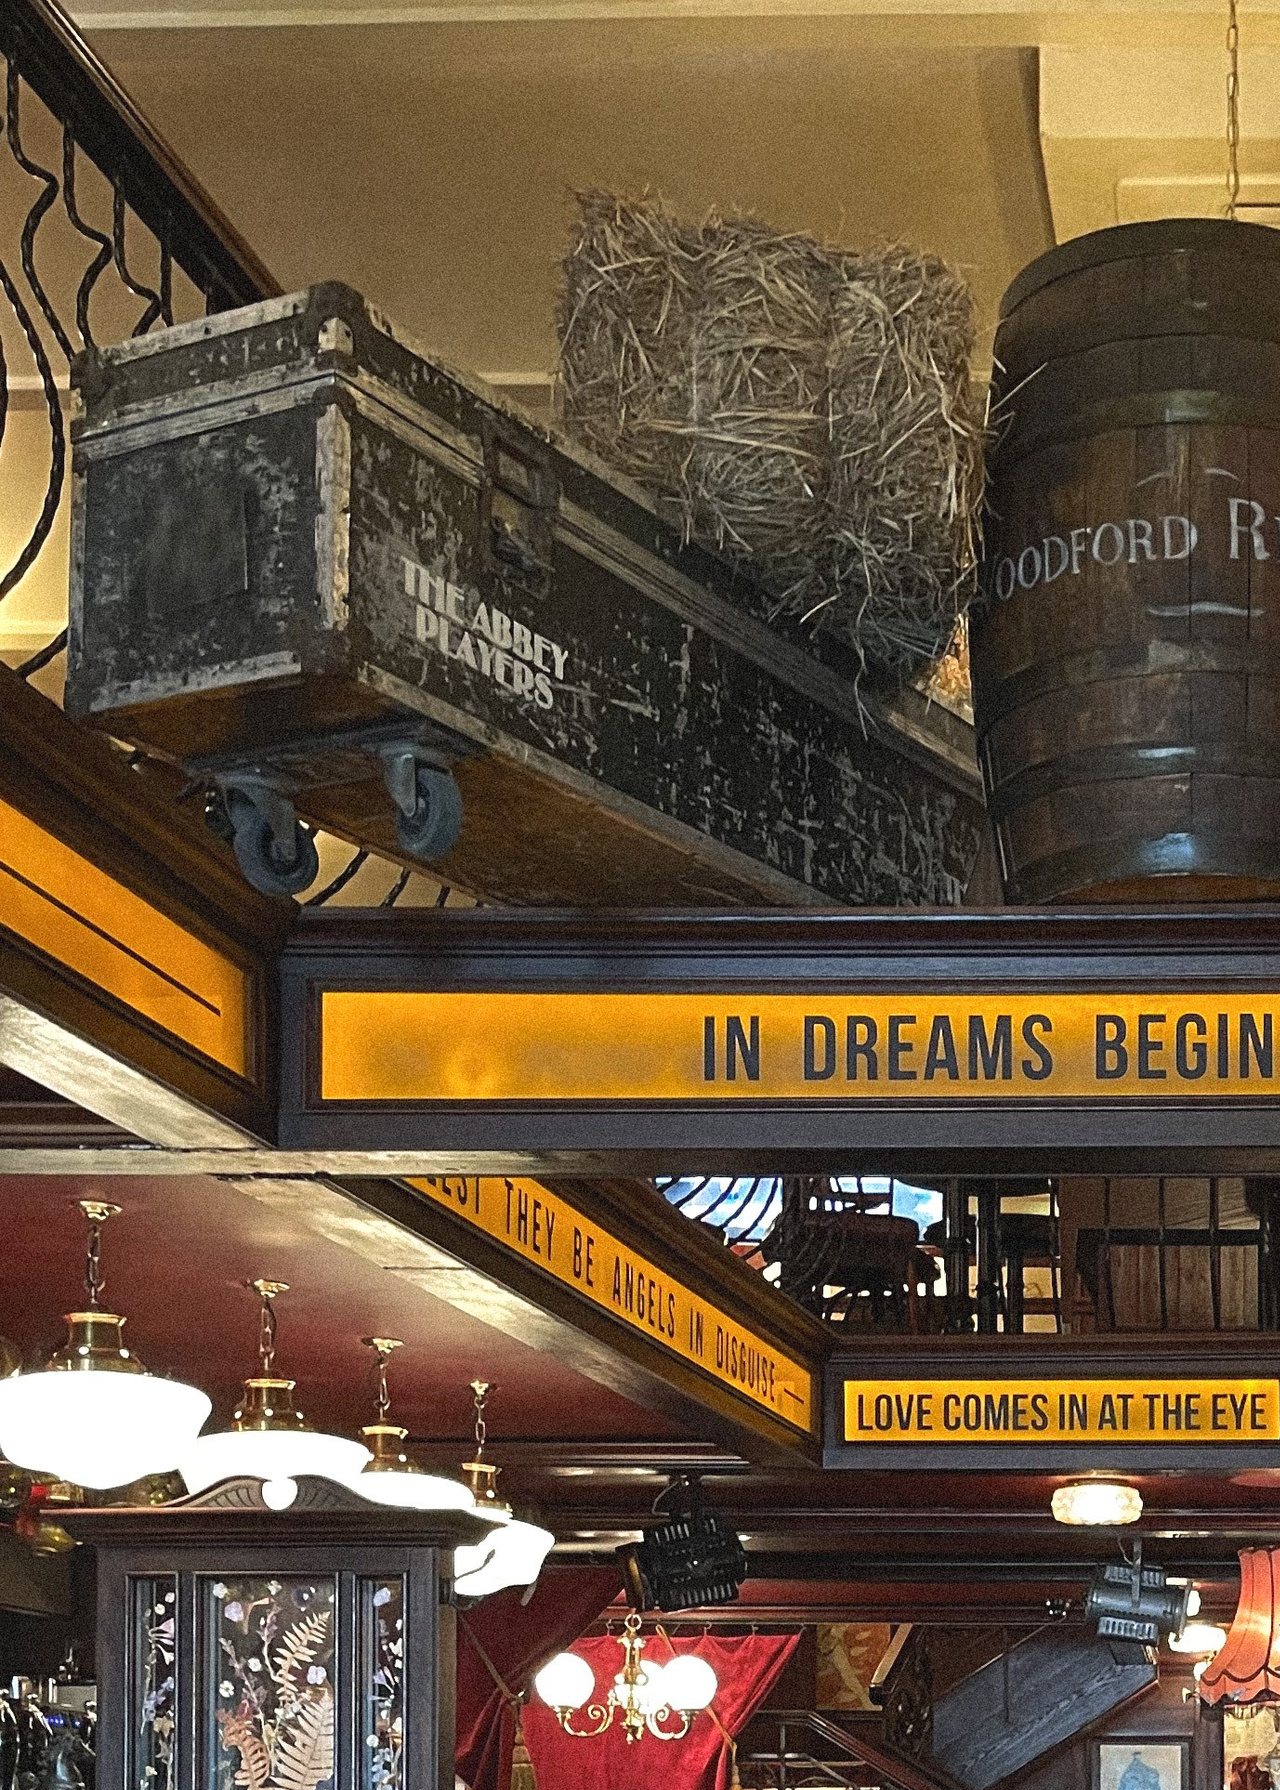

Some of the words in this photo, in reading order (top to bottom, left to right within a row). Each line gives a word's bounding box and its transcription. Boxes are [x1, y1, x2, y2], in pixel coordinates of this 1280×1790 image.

[993, 516, 1198, 601] OODFORD
[401, 555, 466, 626] THE
[471, 602, 569, 681] ABBEY
[416, 604, 554, 710] PLAYERS
[703, 1016, 760, 1081] IN
[803, 1014, 1054, 1081] DREAMS
[1096, 1013, 1274, 1080] BEGIN
[504, 1178, 556, 1261] THEY
[573, 1226, 595, 1287] BE
[612, 1256, 676, 1339] ANGELS
[690, 1307, 704, 1358] IN
[716, 1325, 776, 1403] DISGUISE
[858, 1394, 932, 1431] LOVE
[943, 1394, 1048, 1431] COMES
[1059, 1394, 1088, 1430] IN
[1098, 1394, 1132, 1430] AT
[1143, 1394, 1200, 1431] THE
[1211, 1394, 1267, 1430] EYE
